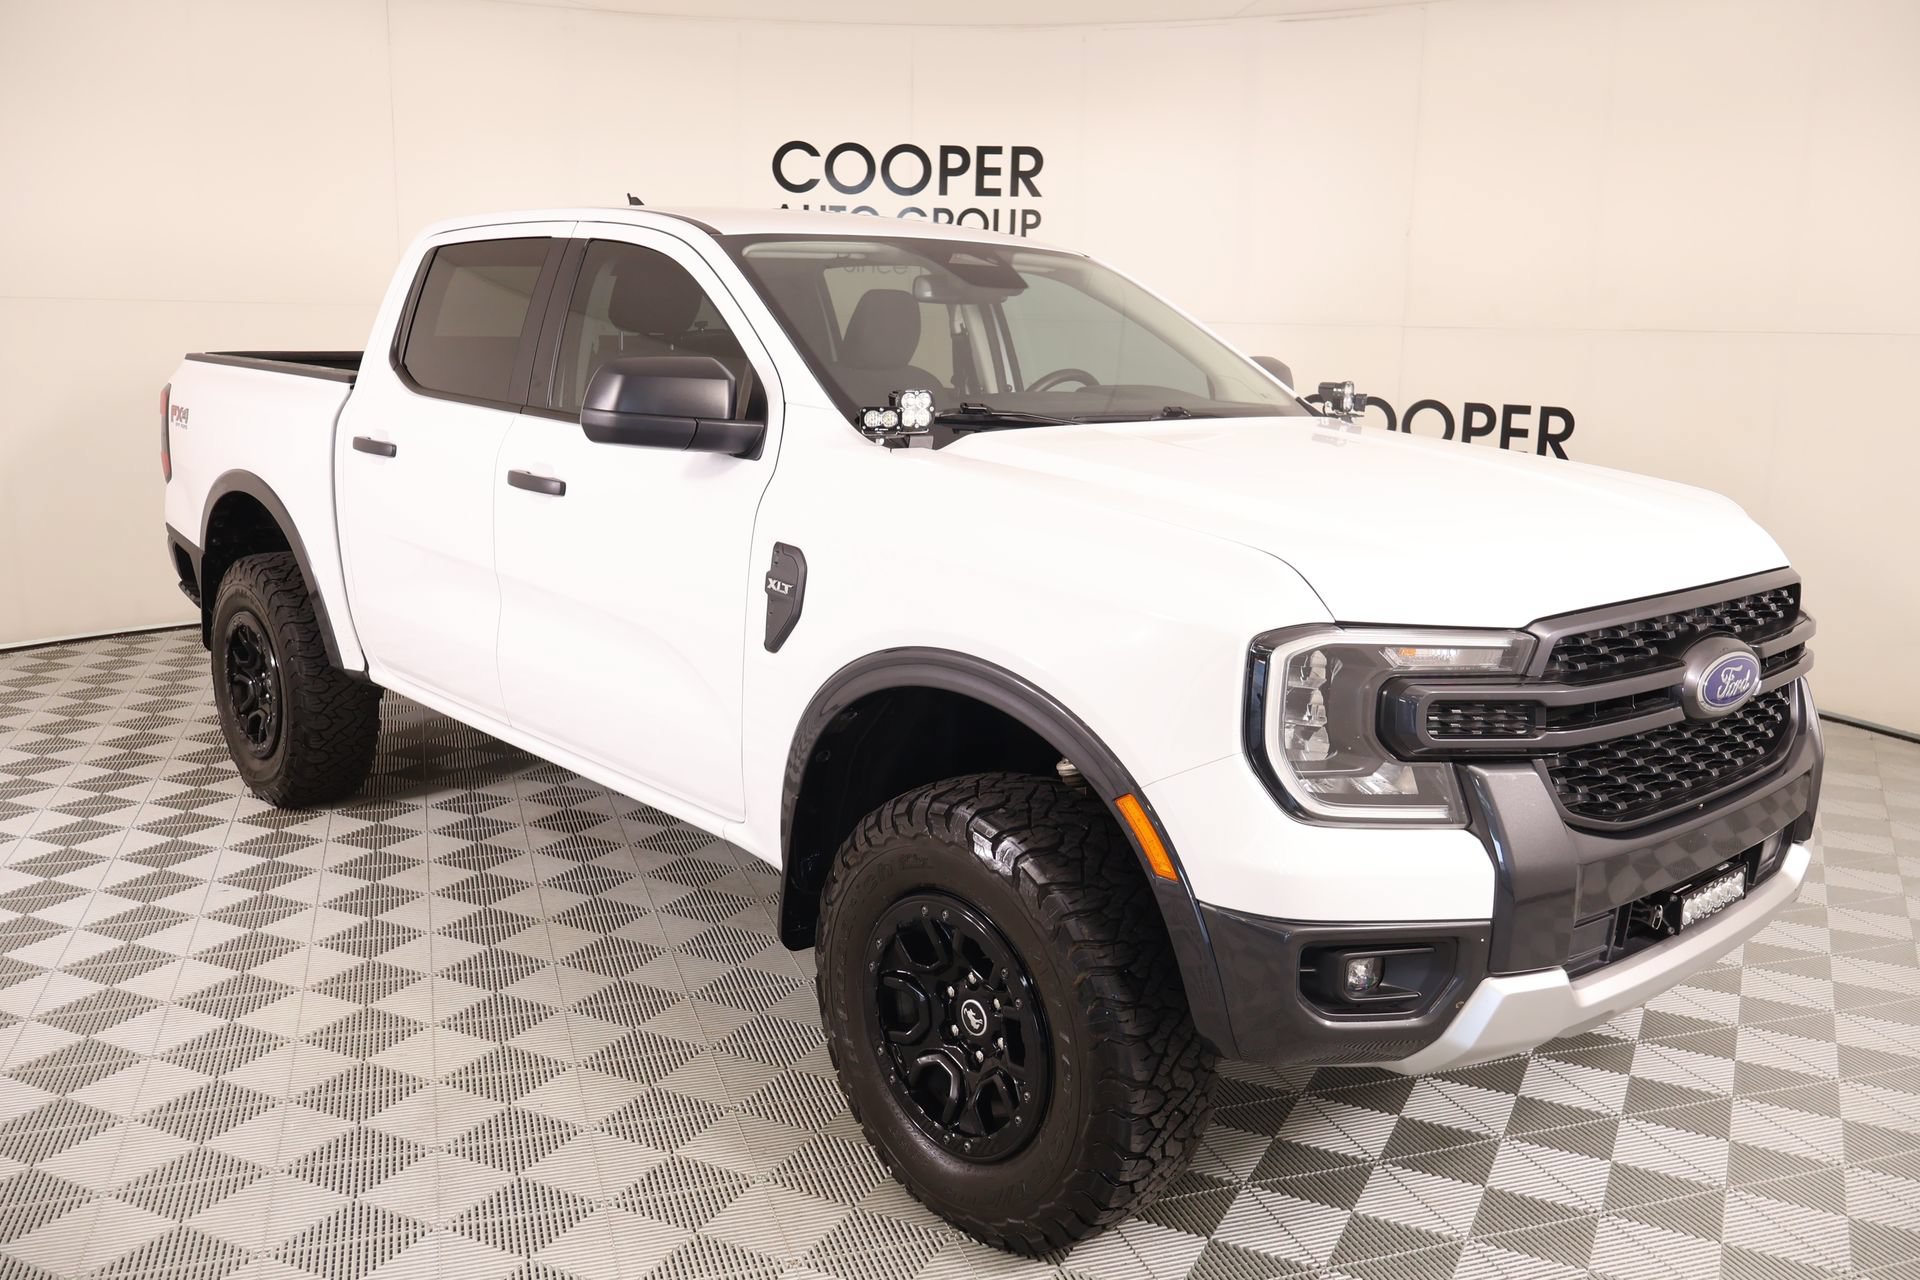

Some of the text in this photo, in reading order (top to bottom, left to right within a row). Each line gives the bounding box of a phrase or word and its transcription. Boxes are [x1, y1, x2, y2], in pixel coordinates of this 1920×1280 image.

[771, 140, 1044, 198] COOPER
[170, 404, 190, 425] FX4
[766, 577, 794, 595] XLT
[1715, 663, 1751, 701] Ford
